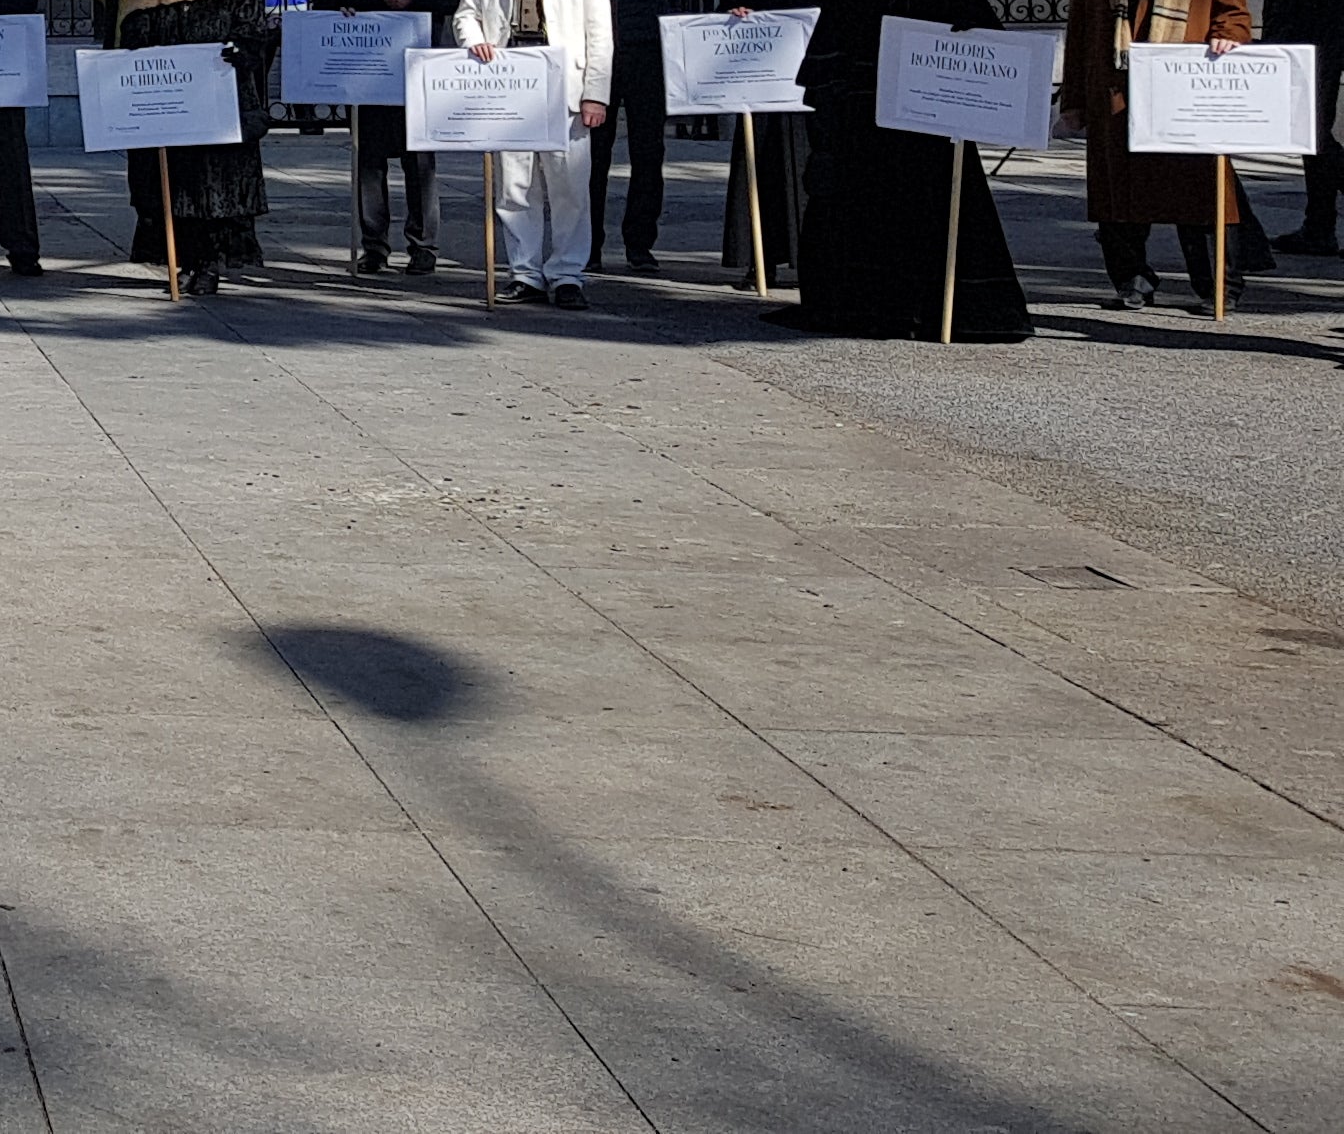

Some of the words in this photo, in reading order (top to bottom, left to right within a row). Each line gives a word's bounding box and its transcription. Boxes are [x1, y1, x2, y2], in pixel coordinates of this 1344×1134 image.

[333, 22, 381, 34] ISIDORO
[321, 36, 335, 47] DE
[713, 42, 773, 55] ZARZOSO
[935, 39, 996, 60] DOLORES
[134, 58, 176, 72] ELVIRA
[911, 52, 967, 73] ROMERO
[1164, 62, 1220, 75] VICENTE
[1222, 62, 1277, 75] IRANZO
[120, 75, 137, 88] DE
[138, 72, 193, 86] HIDALGO
[432, 79, 449, 91] DE
[509, 78, 539, 91] RUIZ
[1191, 78, 1250, 91] ENGUITA
